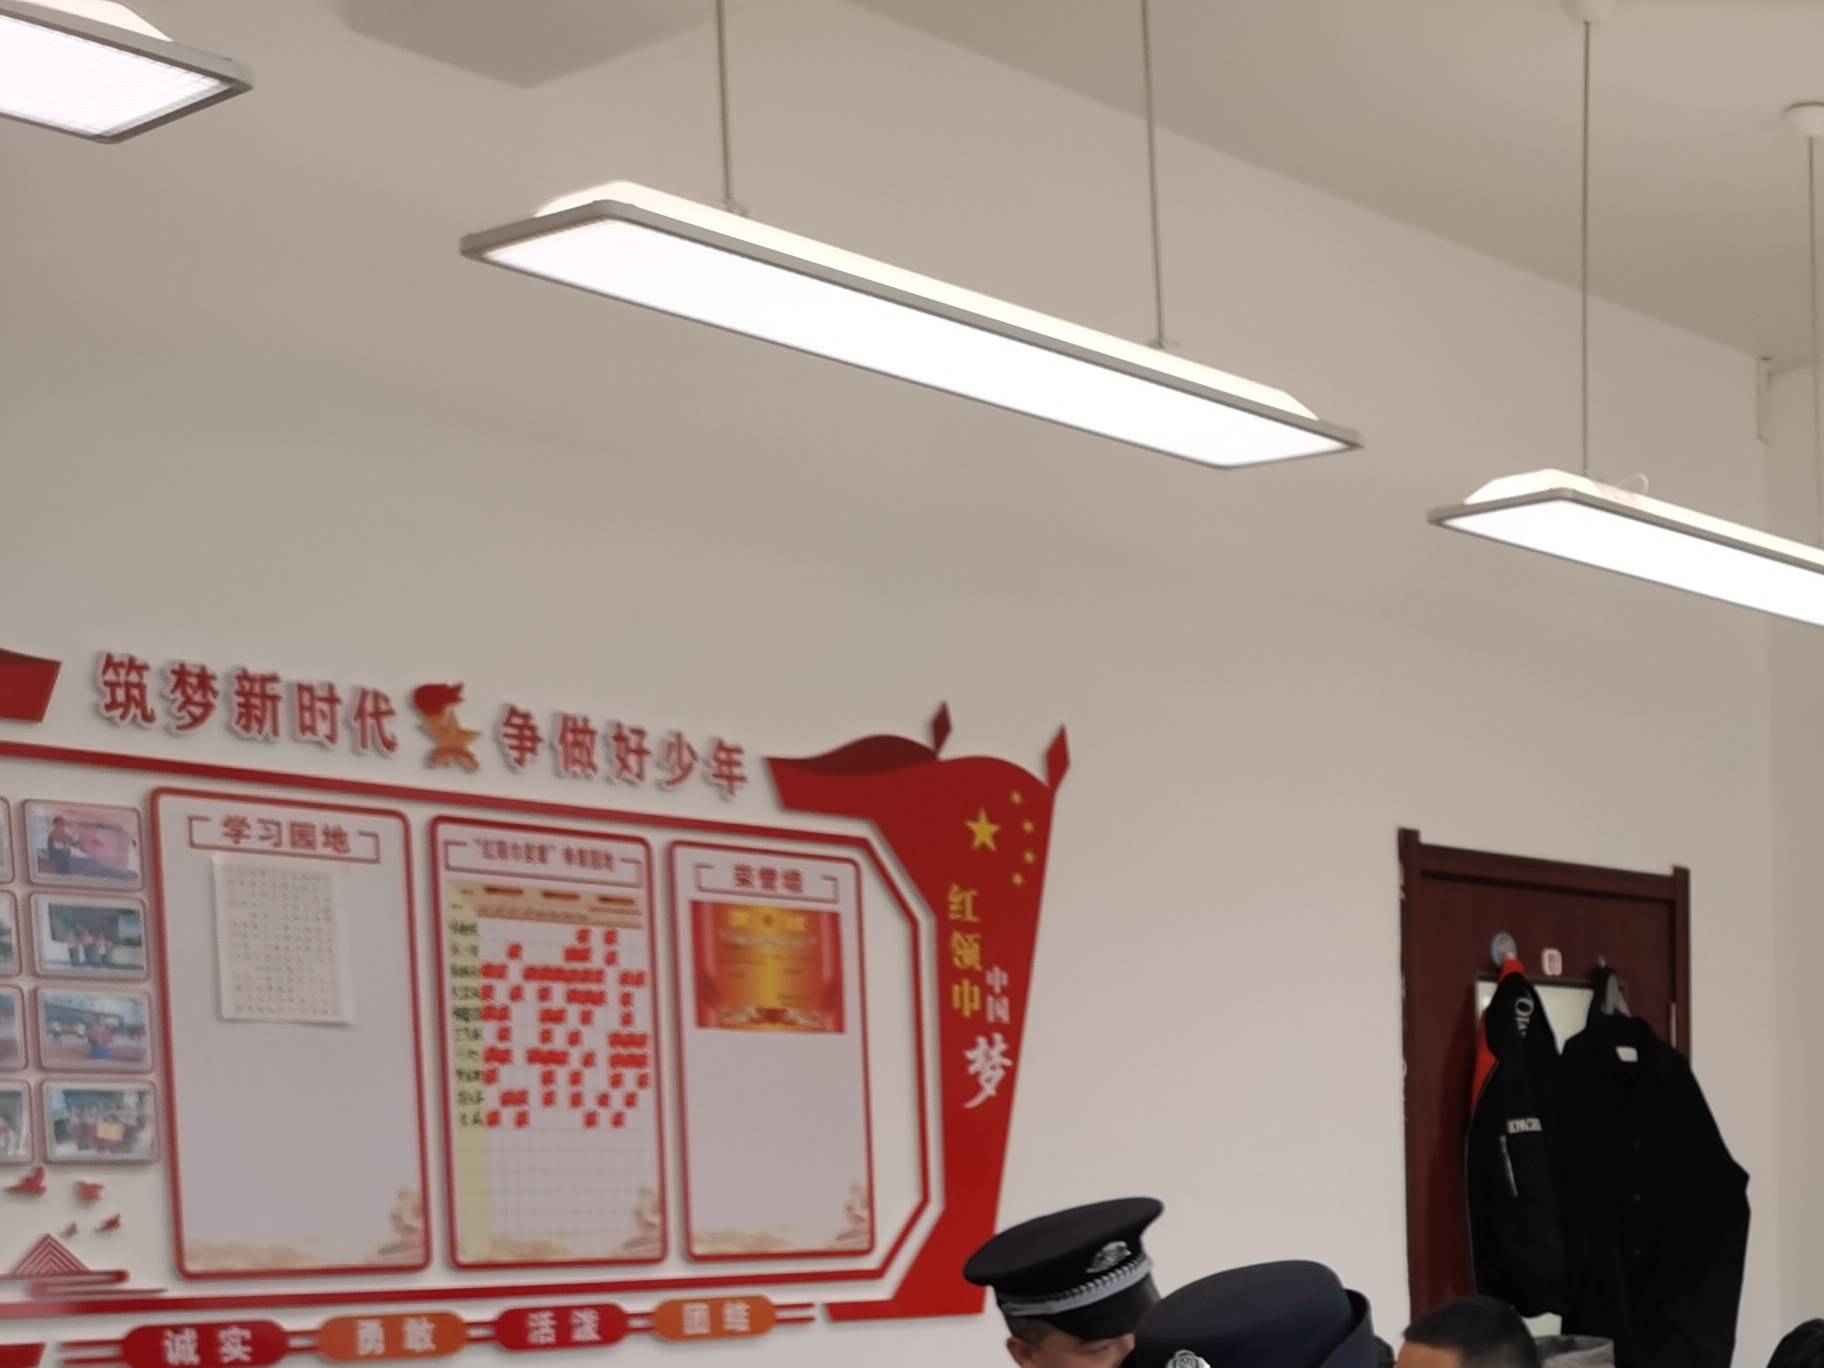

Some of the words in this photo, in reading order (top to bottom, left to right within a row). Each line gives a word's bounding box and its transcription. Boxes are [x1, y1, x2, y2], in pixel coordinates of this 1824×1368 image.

[101, 652, 398, 753] 筑梦新时代
[502, 704, 749, 798] 争做好少年
[222, 814, 351, 854] 学习园地
[947, 884, 981, 1018] 红领巾
[356, 1318, 436, 1356] 勇敢
[527, 1308, 600, 1345] 活泼
[682, 1301, 750, 1335] 团结
[163, 1325, 252, 1366] 诚实
